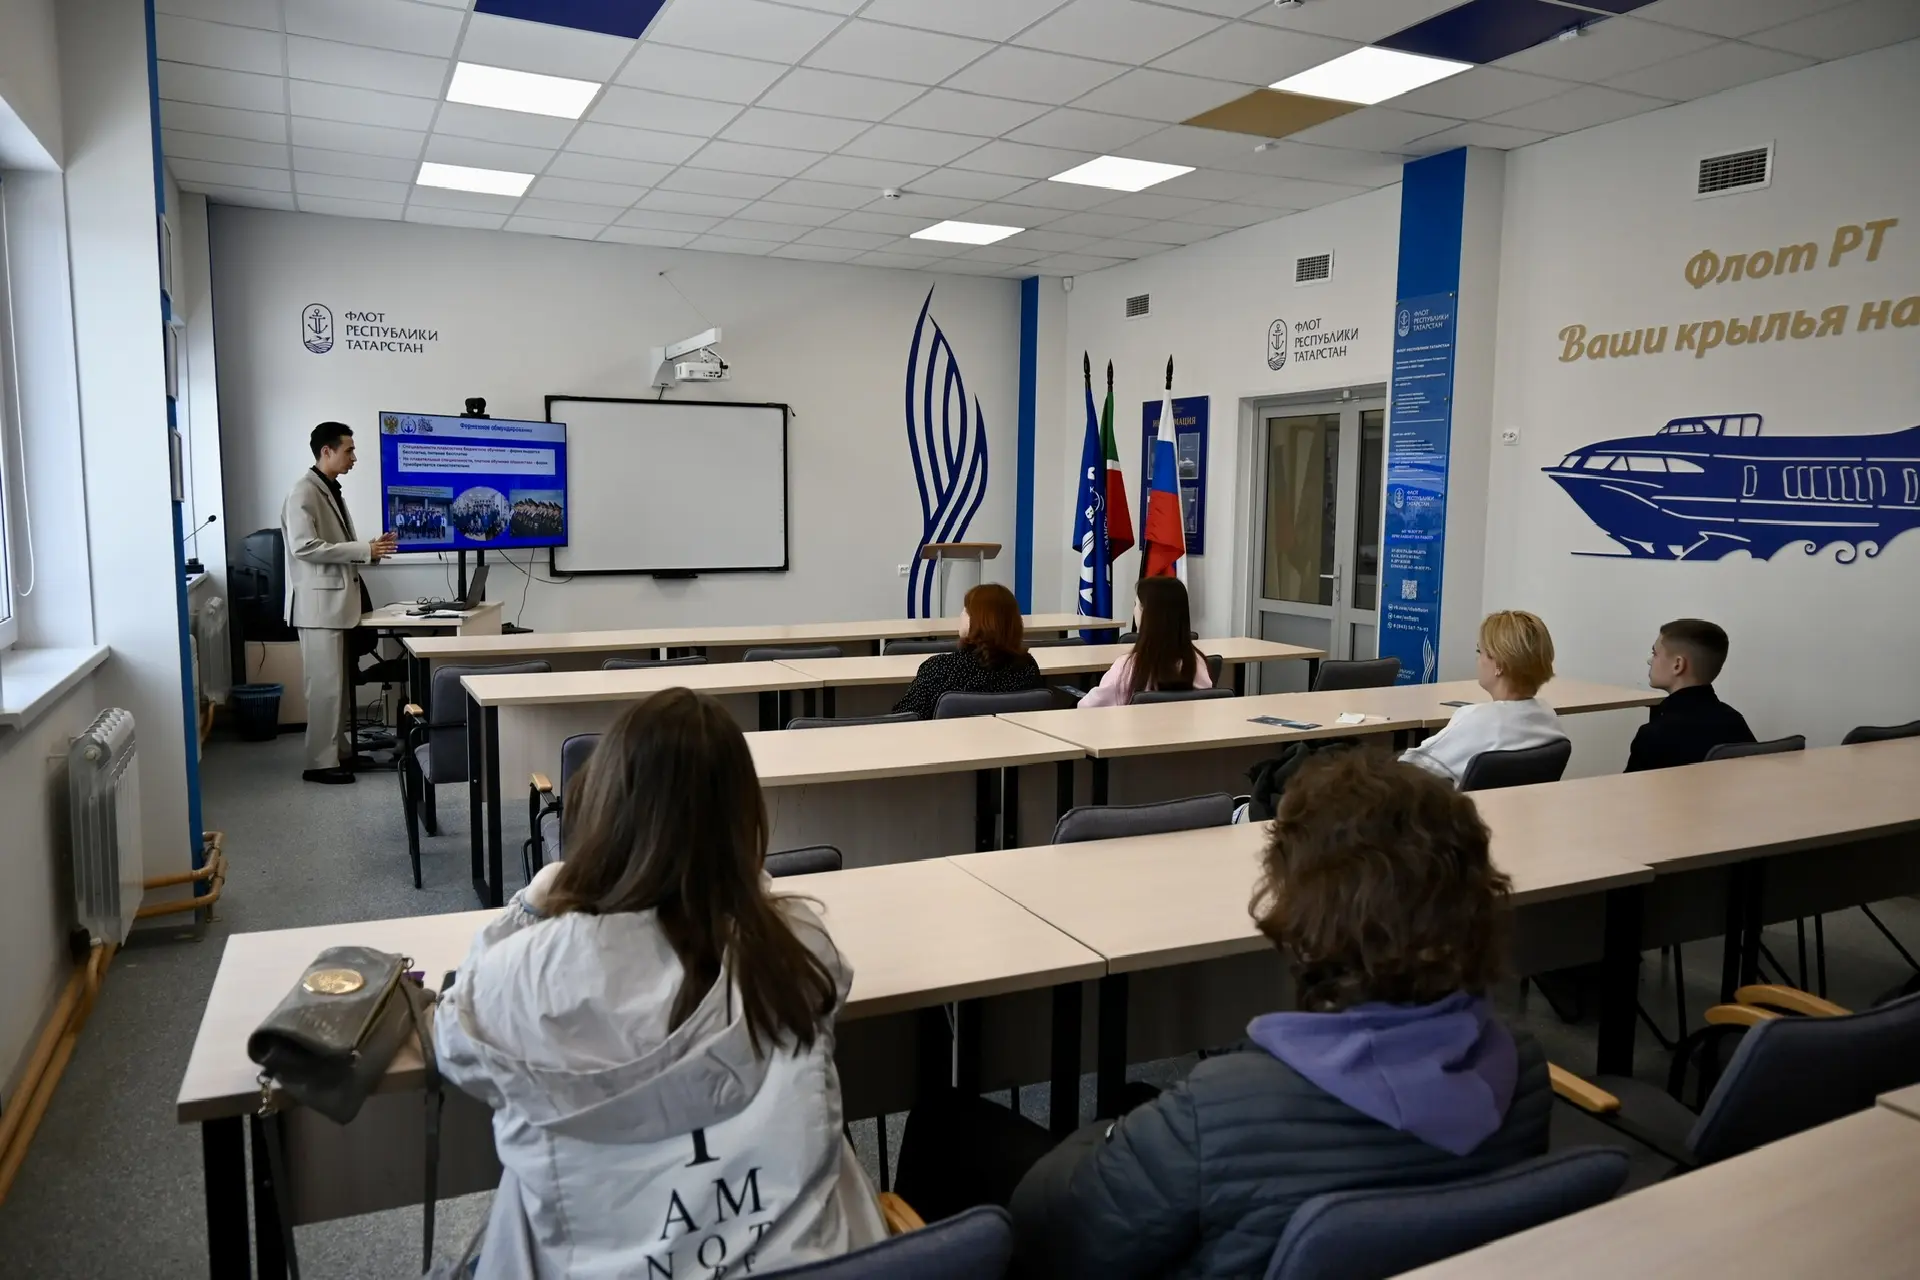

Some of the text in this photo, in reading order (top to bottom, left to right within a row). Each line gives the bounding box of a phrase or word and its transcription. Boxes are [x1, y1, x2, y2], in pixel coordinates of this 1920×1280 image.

[1684, 218, 1899, 290] Флот РТ
[345, 311, 385, 323] ФЛОТ
[1413, 309, 1429, 317] ФЛОТ
[1413, 314, 1449, 324] РЕСПУБЛИКИ
[346, 324, 438, 341] РЕСПУБЛИКИ
[1294, 318, 1322, 333] ФЛОТ
[1413, 322, 1443, 331] ТАТАРСТАН
[1558, 295, 1920, 363] Ваши крылья на
[345, 339, 424, 353] ТАТАРСТАН
[1294, 328, 1359, 348] РЕСПУБЛИКИ
[1294, 345, 1347, 362] ТАТАРСТАН
[1152, 416, 1196, 427] ИНМАЦИЯ
[659, 1166, 767, 1241] AM
[644, 1220, 774, 1280] NOT
